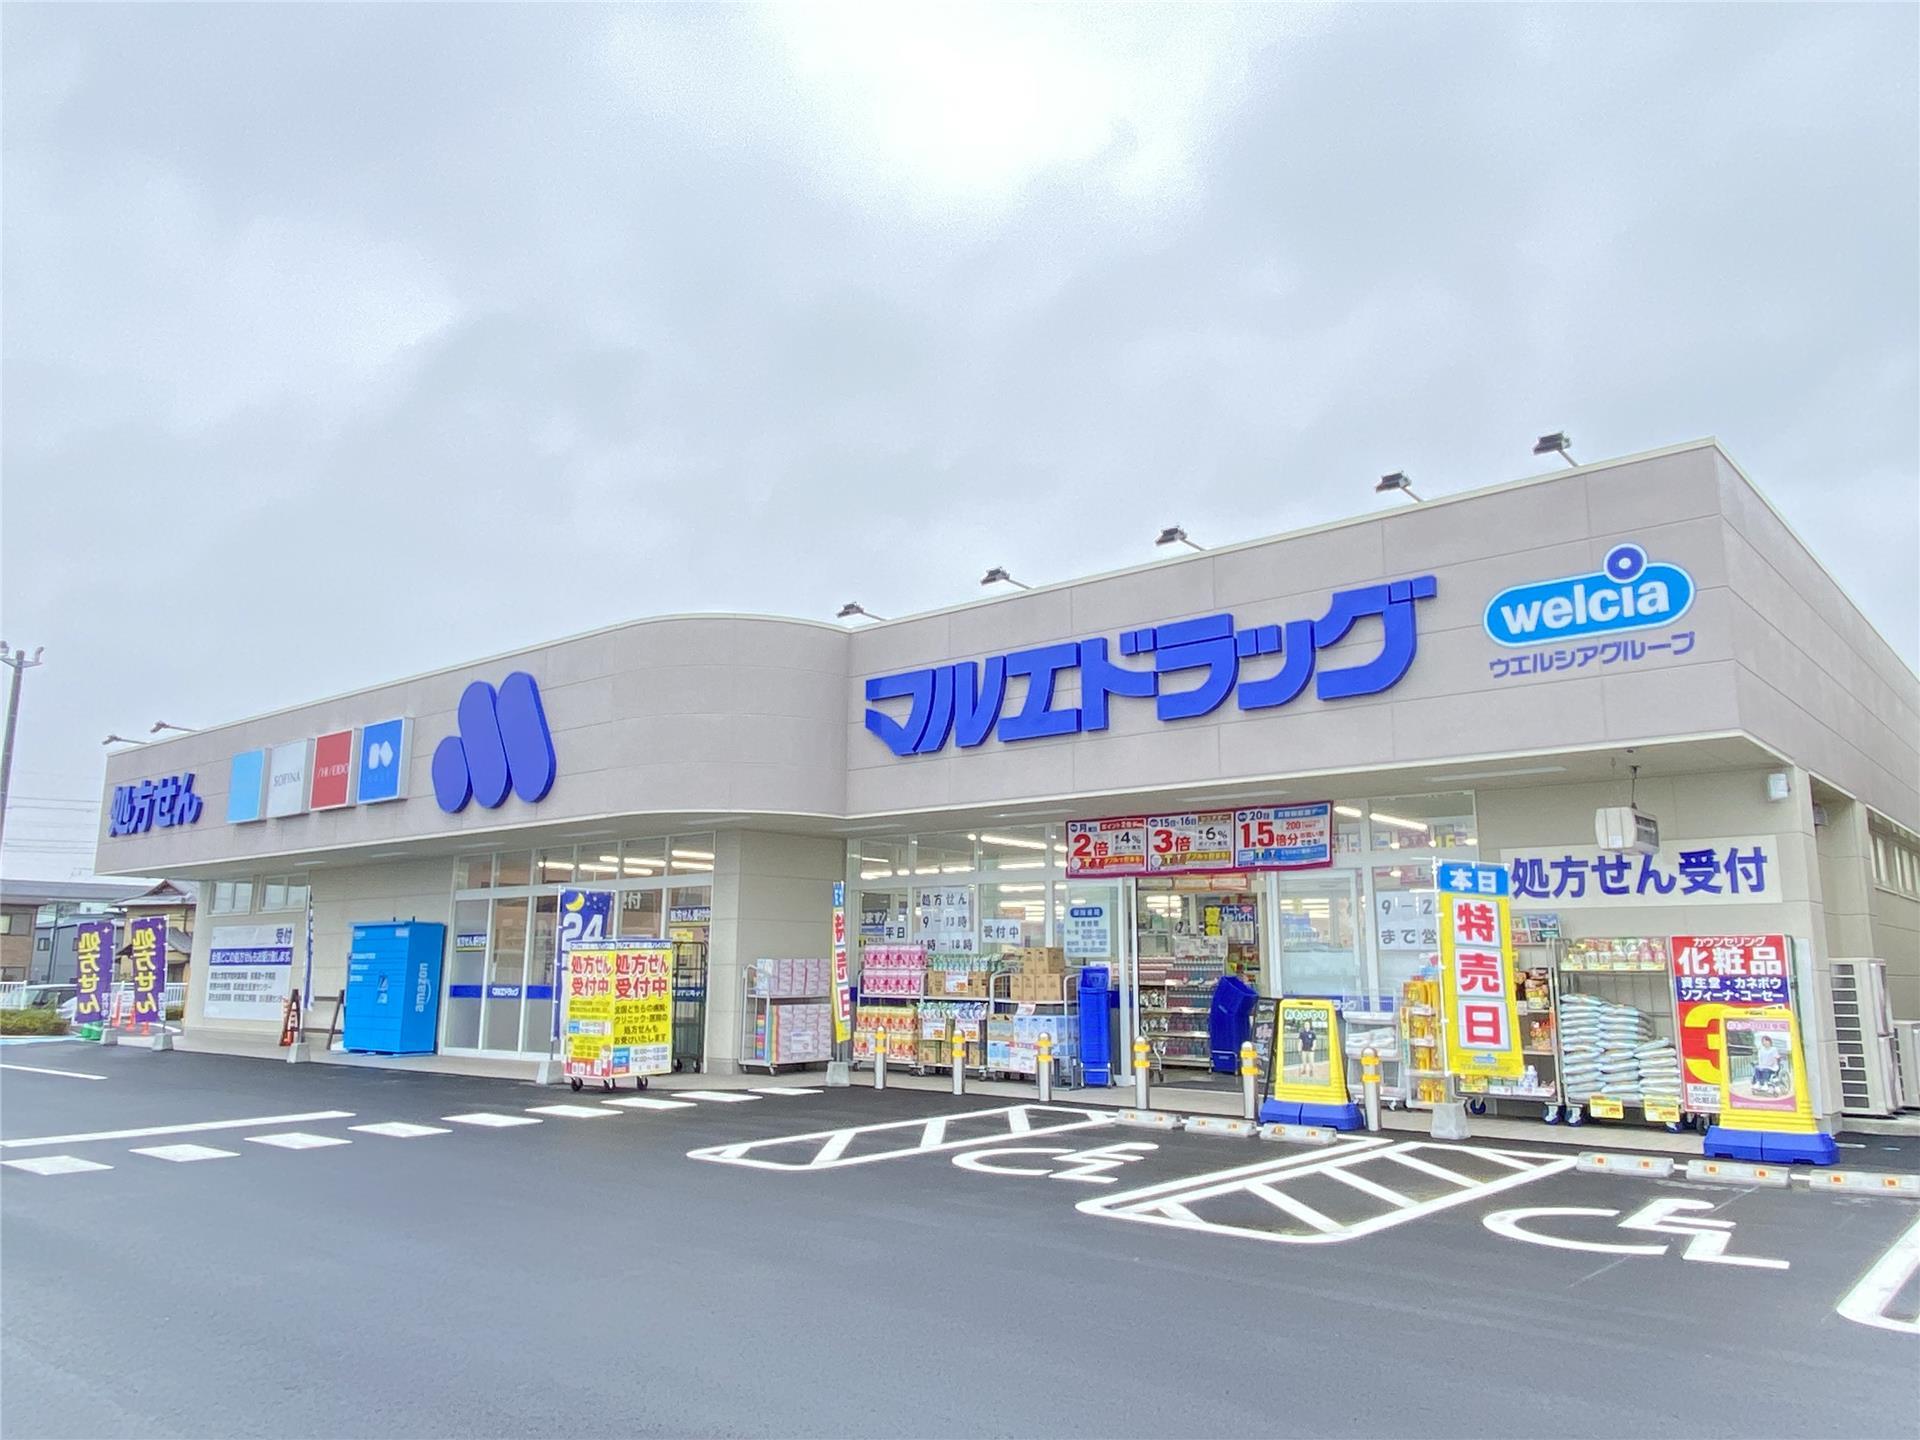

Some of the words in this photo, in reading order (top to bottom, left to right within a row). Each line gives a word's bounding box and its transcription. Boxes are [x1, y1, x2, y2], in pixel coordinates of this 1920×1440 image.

[1501, 579, 1670, 635] welcia
[865, 575, 1436, 755] マルエドラッグ
[1489, 631, 1696, 678] ウエルシアグループ
[109, 772, 203, 838] 処方せん
[1449, 868, 1496, 890] 本日
[1511, 846, 1768, 900] 処方せん受付
[922, 894, 967, 906] 処方せん
[275, 927, 293, 945] 受付
[885, 927, 905, 939] 平日
[983, 926, 1019, 939] 受付中
[1693, 936, 1767, 947] カウンセリング
[571, 955, 611, 975] 処方せん
[615, 953, 669, 975] 処方せん
[1678, 946, 1782, 976] 化粧品
[1456, 902, 1502, 1045] 特売日
[414, 962, 429, 1013] amazon
[571, 977, 609, 997] 受付中
[615, 977, 668, 999] 受付中
